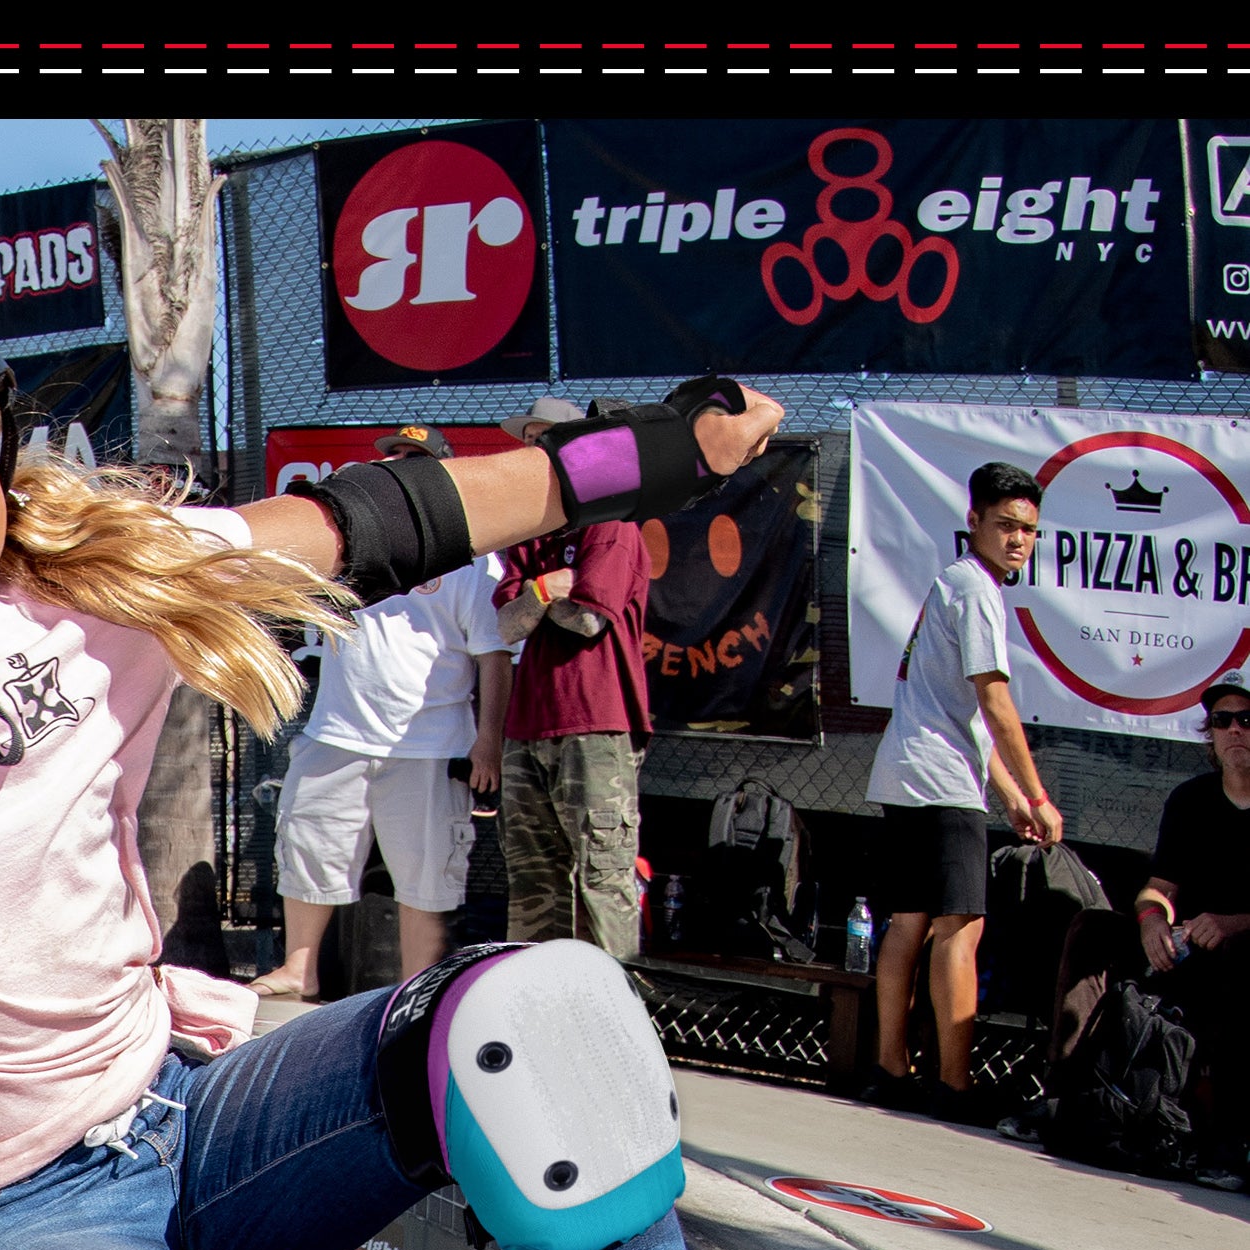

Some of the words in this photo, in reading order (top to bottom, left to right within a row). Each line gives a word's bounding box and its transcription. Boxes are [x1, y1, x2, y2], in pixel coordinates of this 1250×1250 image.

[572, 188, 786, 254] triple
[916, 176, 1161, 244] eight
[1055, 530, 1163, 595] PIZZA
[1172, 537, 1203, 600] &
[1080, 625, 1121, 643] SAN
[1128, 630, 1195, 651] DIEGO
